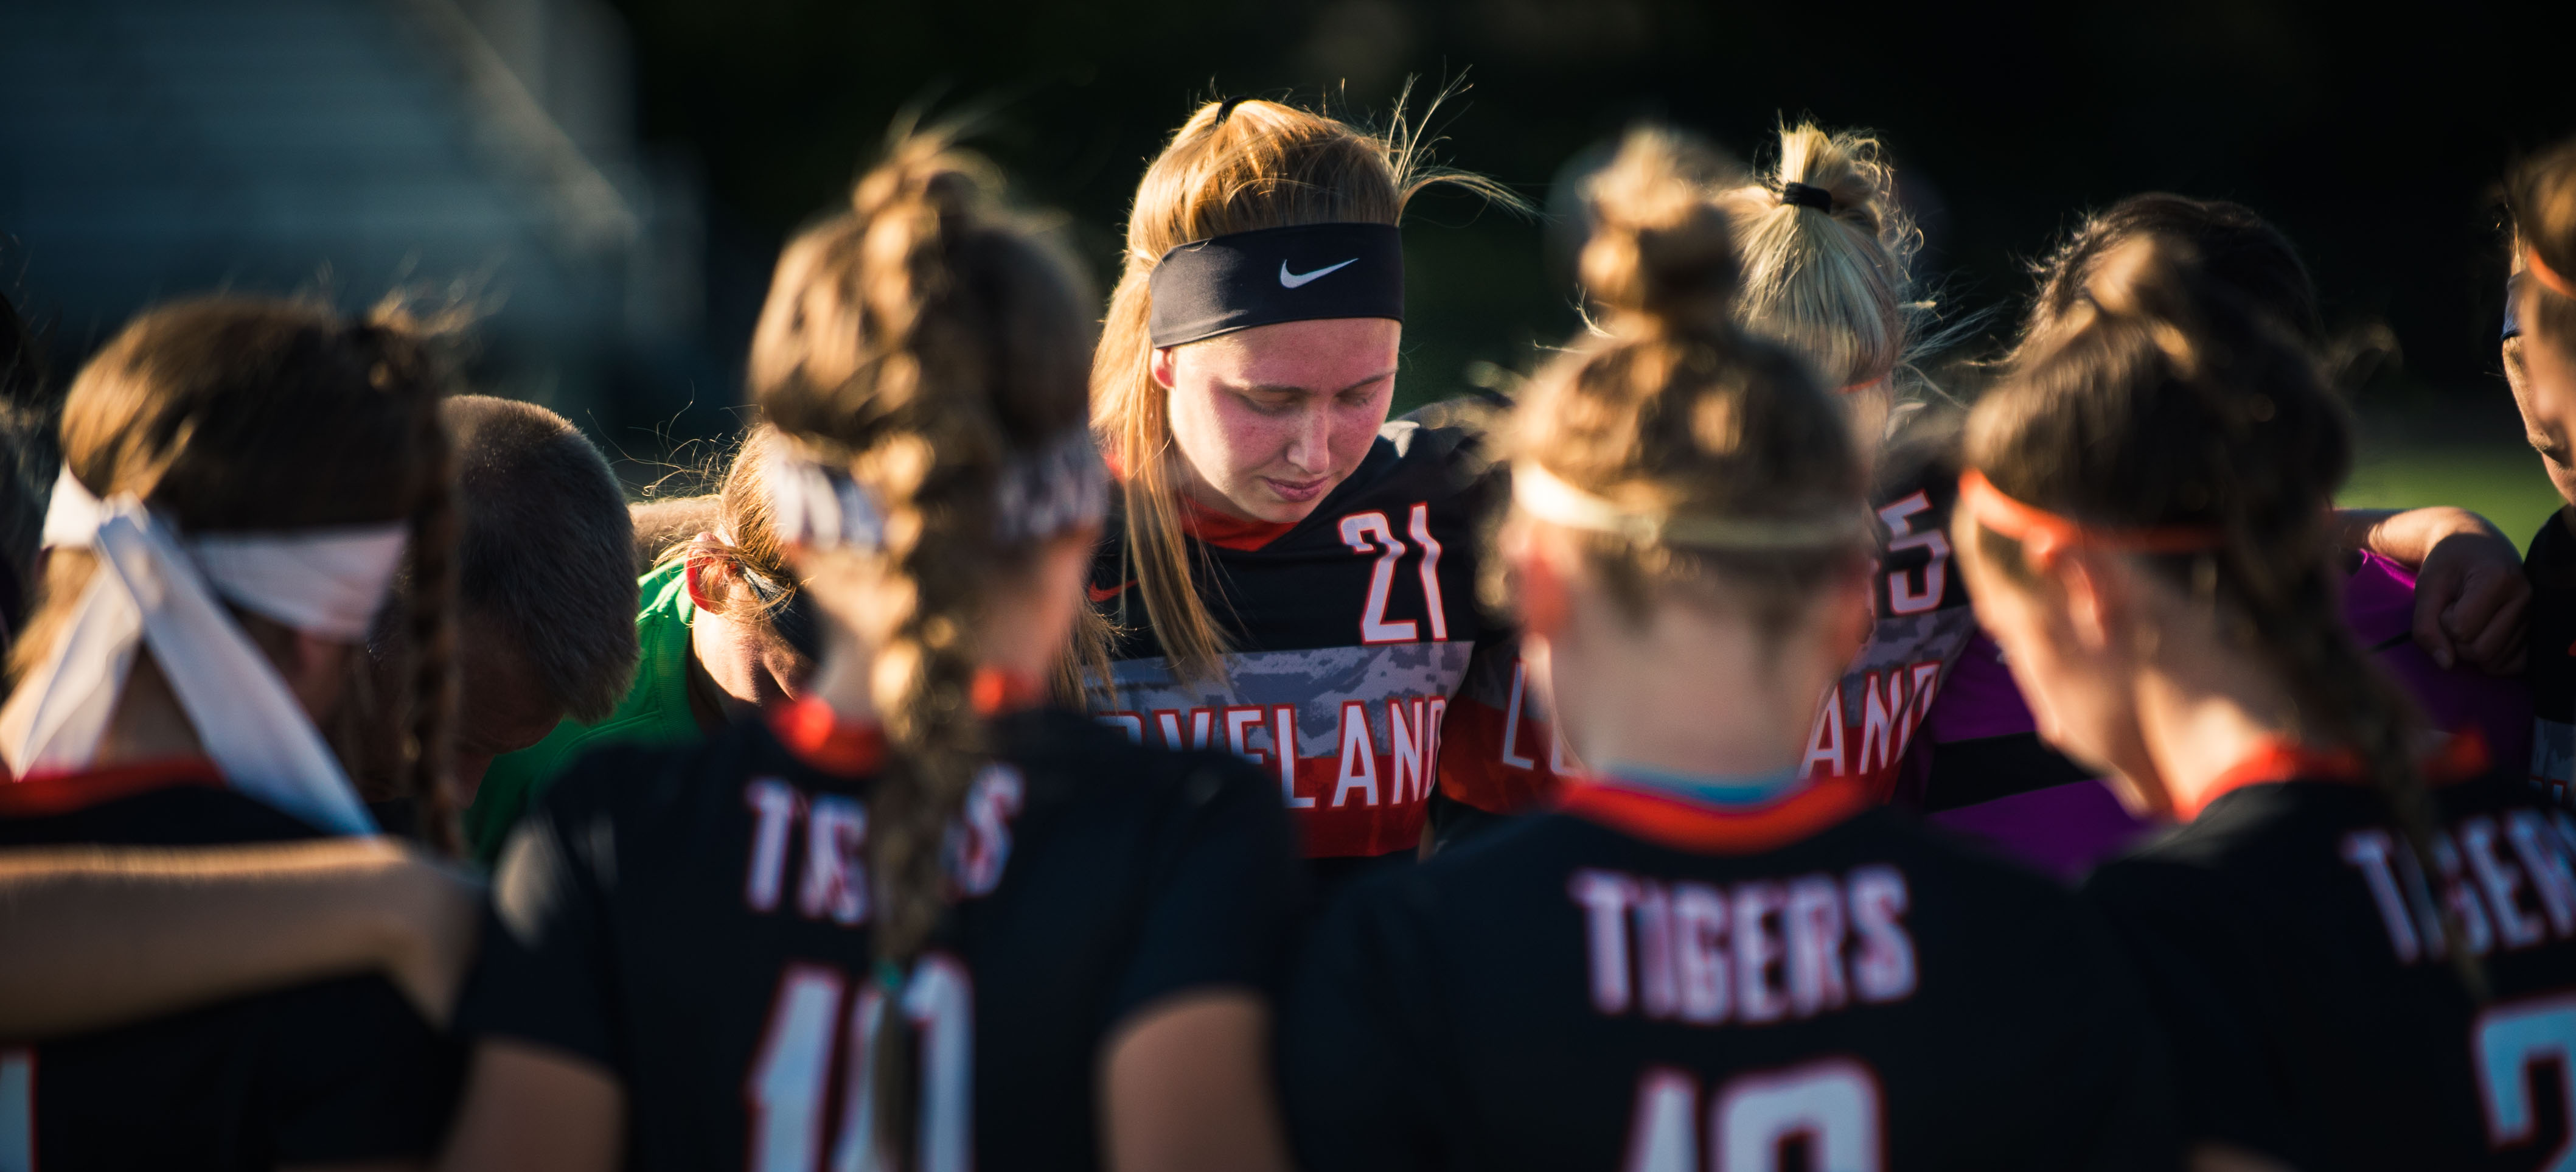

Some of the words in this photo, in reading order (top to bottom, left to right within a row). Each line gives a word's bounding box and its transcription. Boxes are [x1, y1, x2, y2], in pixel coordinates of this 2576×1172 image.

[1338, 501, 1449, 644] 21
[1868, 487, 1951, 616] 5
[1567, 864, 1920, 1026] TIGERS
